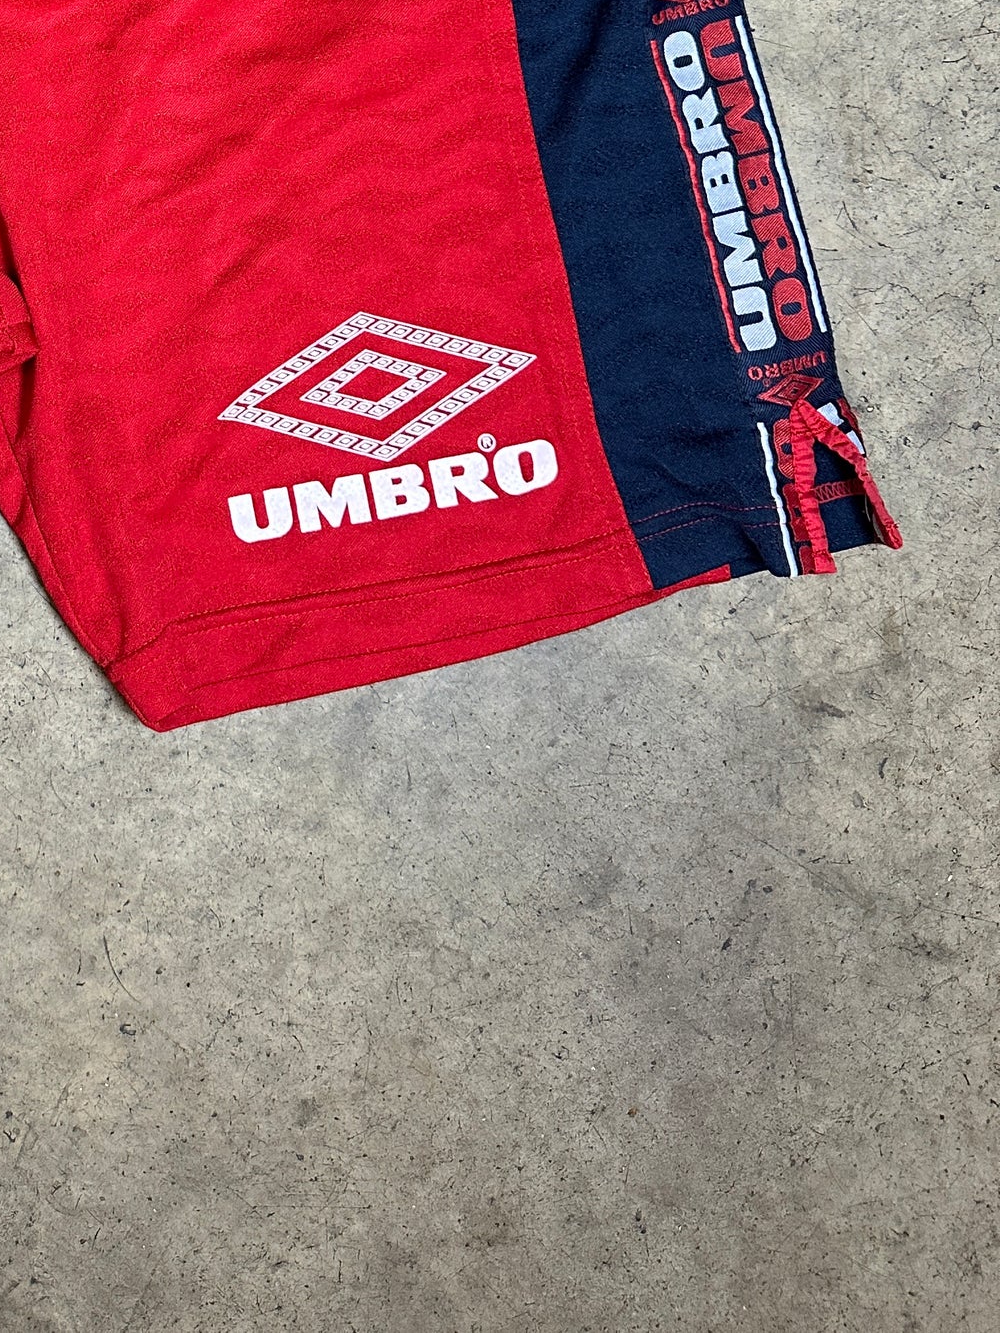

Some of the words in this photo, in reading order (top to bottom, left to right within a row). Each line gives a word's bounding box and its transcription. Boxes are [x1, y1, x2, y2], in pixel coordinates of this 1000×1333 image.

[663, 30, 778, 352] UMBRO
[700, 18, 813, 342] UMBRO
[747, 350, 827, 381] UMBRO
[227, 439, 559, 544] UMBRO
